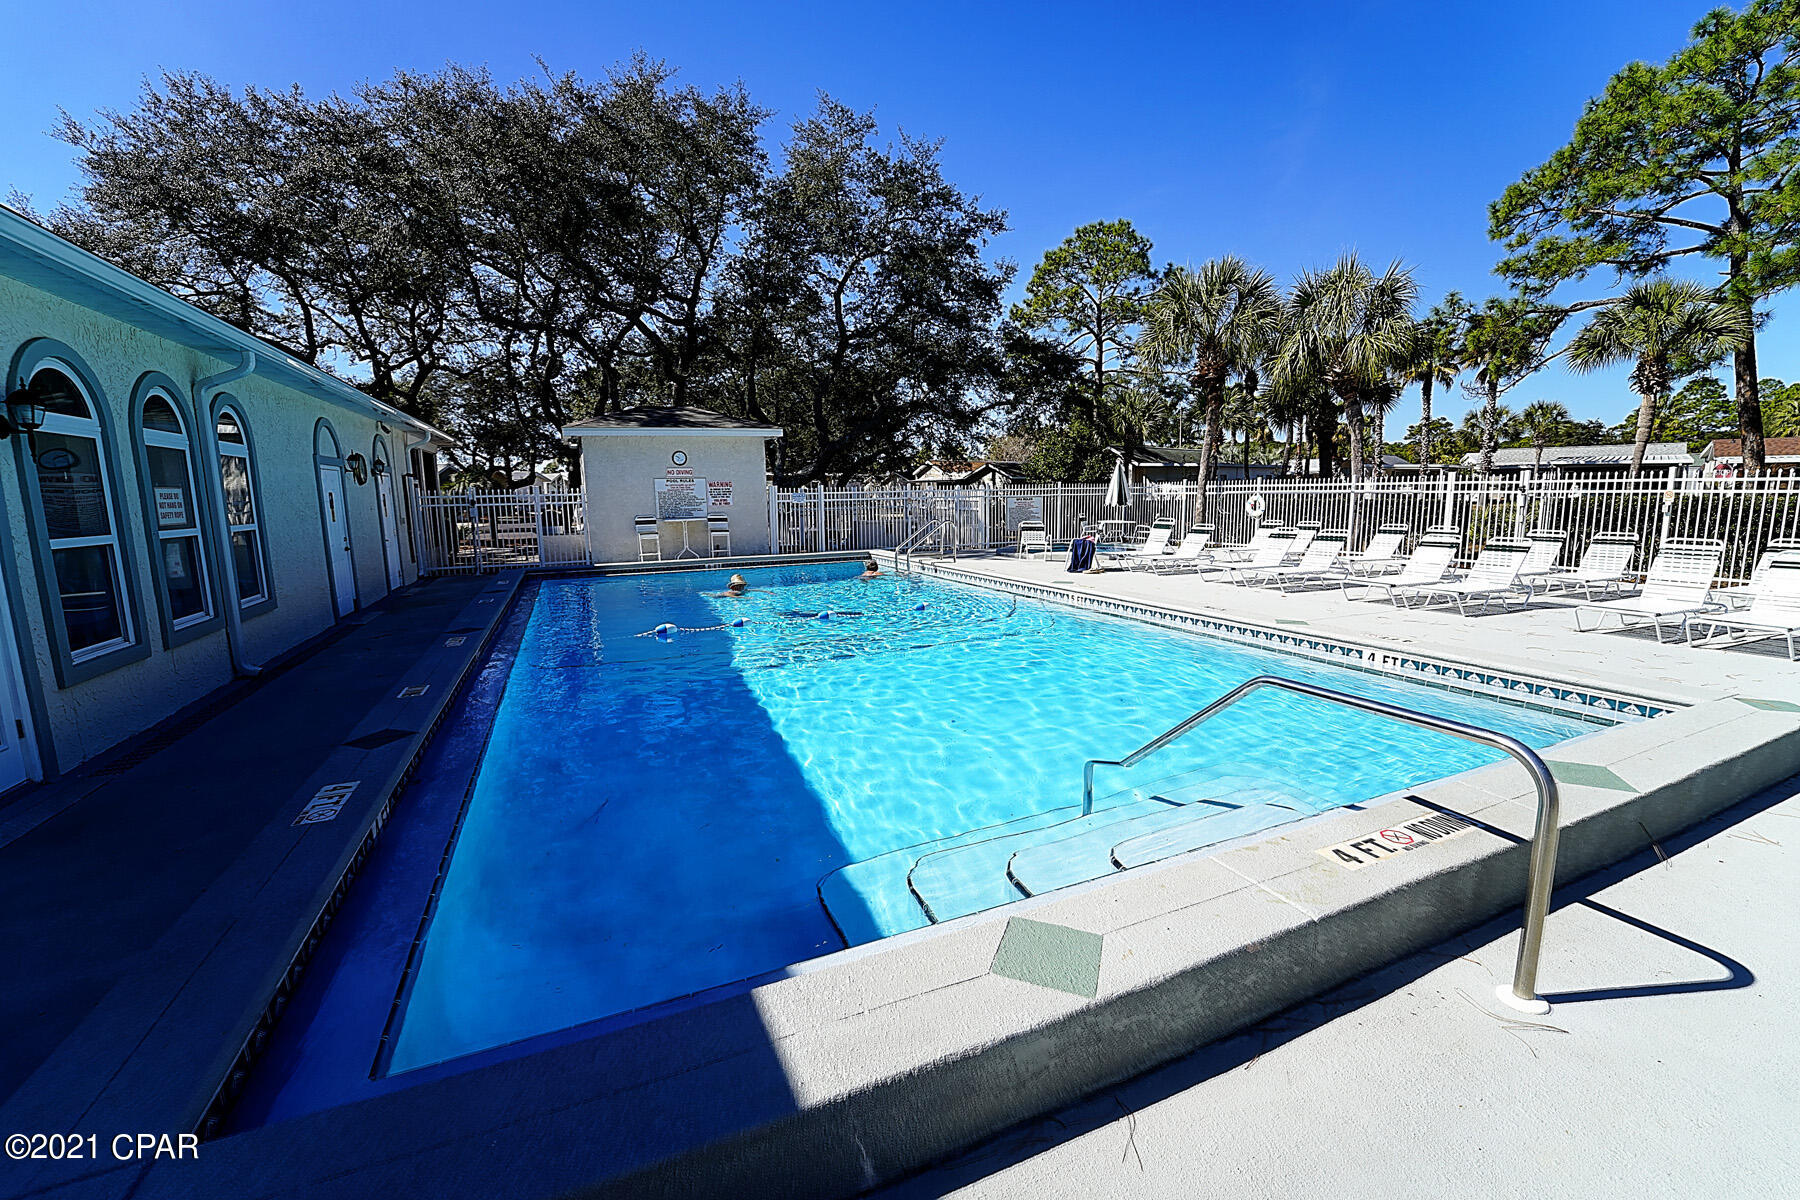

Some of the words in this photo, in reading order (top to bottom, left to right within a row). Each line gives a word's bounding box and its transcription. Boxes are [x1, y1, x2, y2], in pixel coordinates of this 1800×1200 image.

[159, 492, 173, 500] PLEASE
[174, 511, 184, 519] ROPE
[1382, 655, 1399, 666] FT
[1332, 848, 1364, 864] 4
[1350, 838, 1398, 858] FT.
